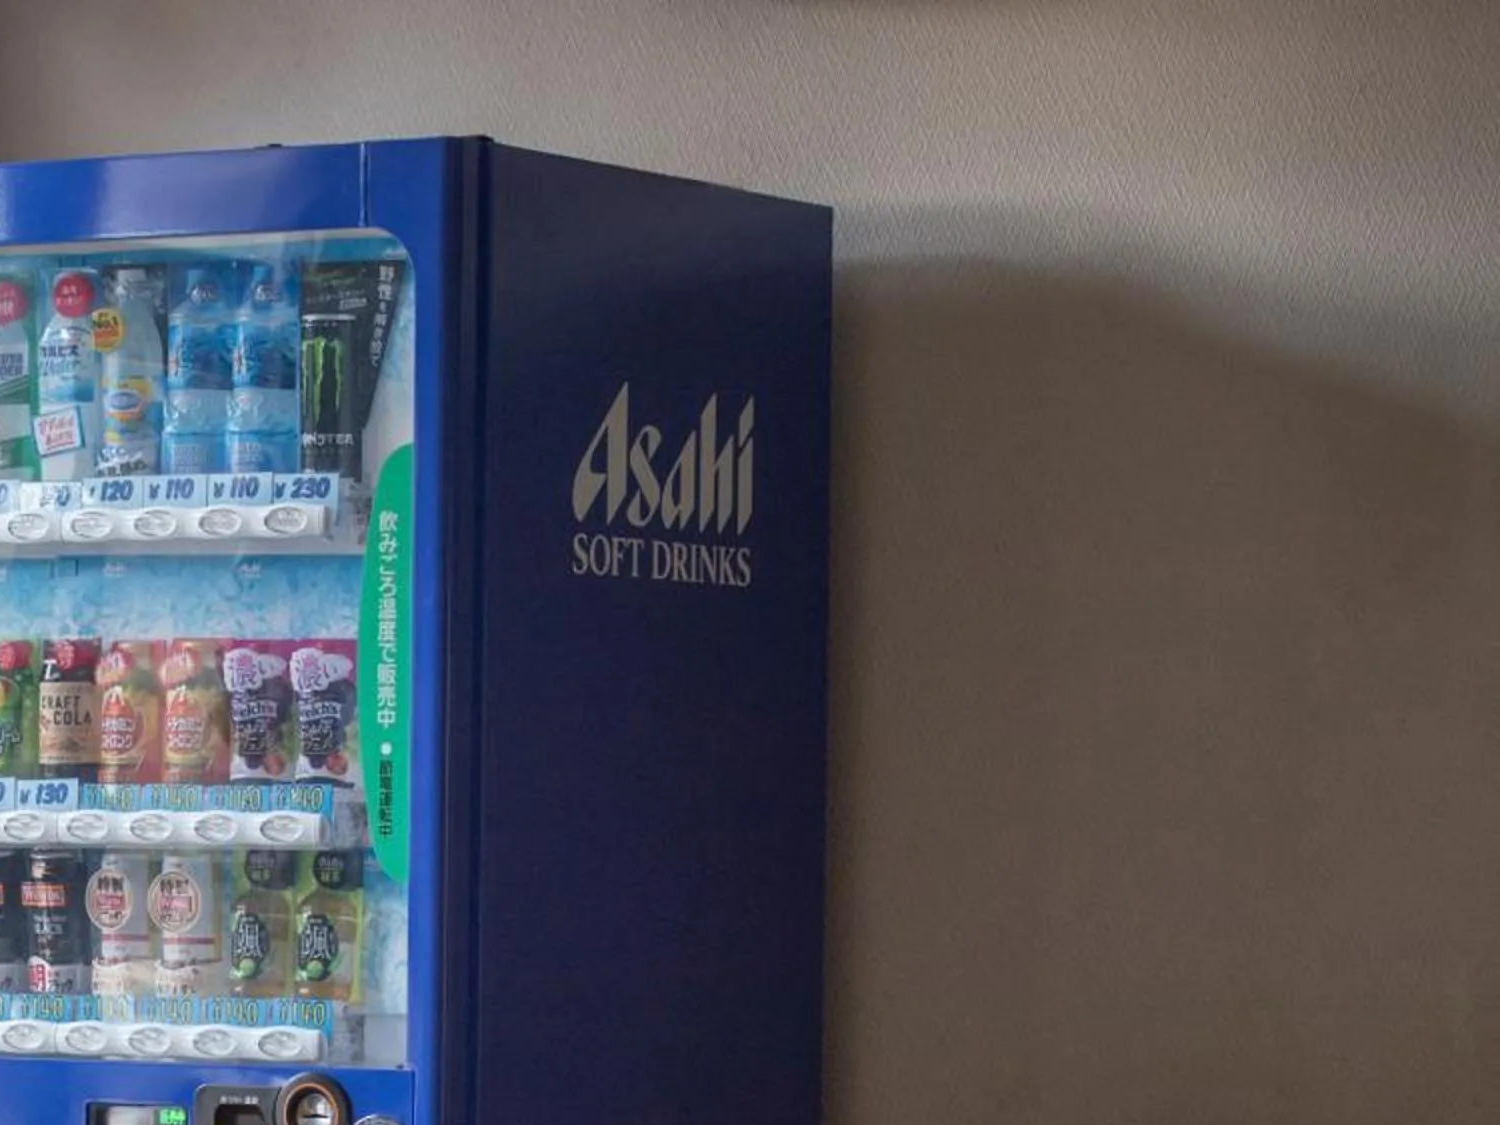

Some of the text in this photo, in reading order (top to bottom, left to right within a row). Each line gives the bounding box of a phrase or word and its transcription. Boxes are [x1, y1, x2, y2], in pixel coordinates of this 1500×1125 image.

[572, 380, 755, 536] Asahi
[573, 533, 751, 588] SOFT DRINKS
[53, 709, 93, 727] COLA
